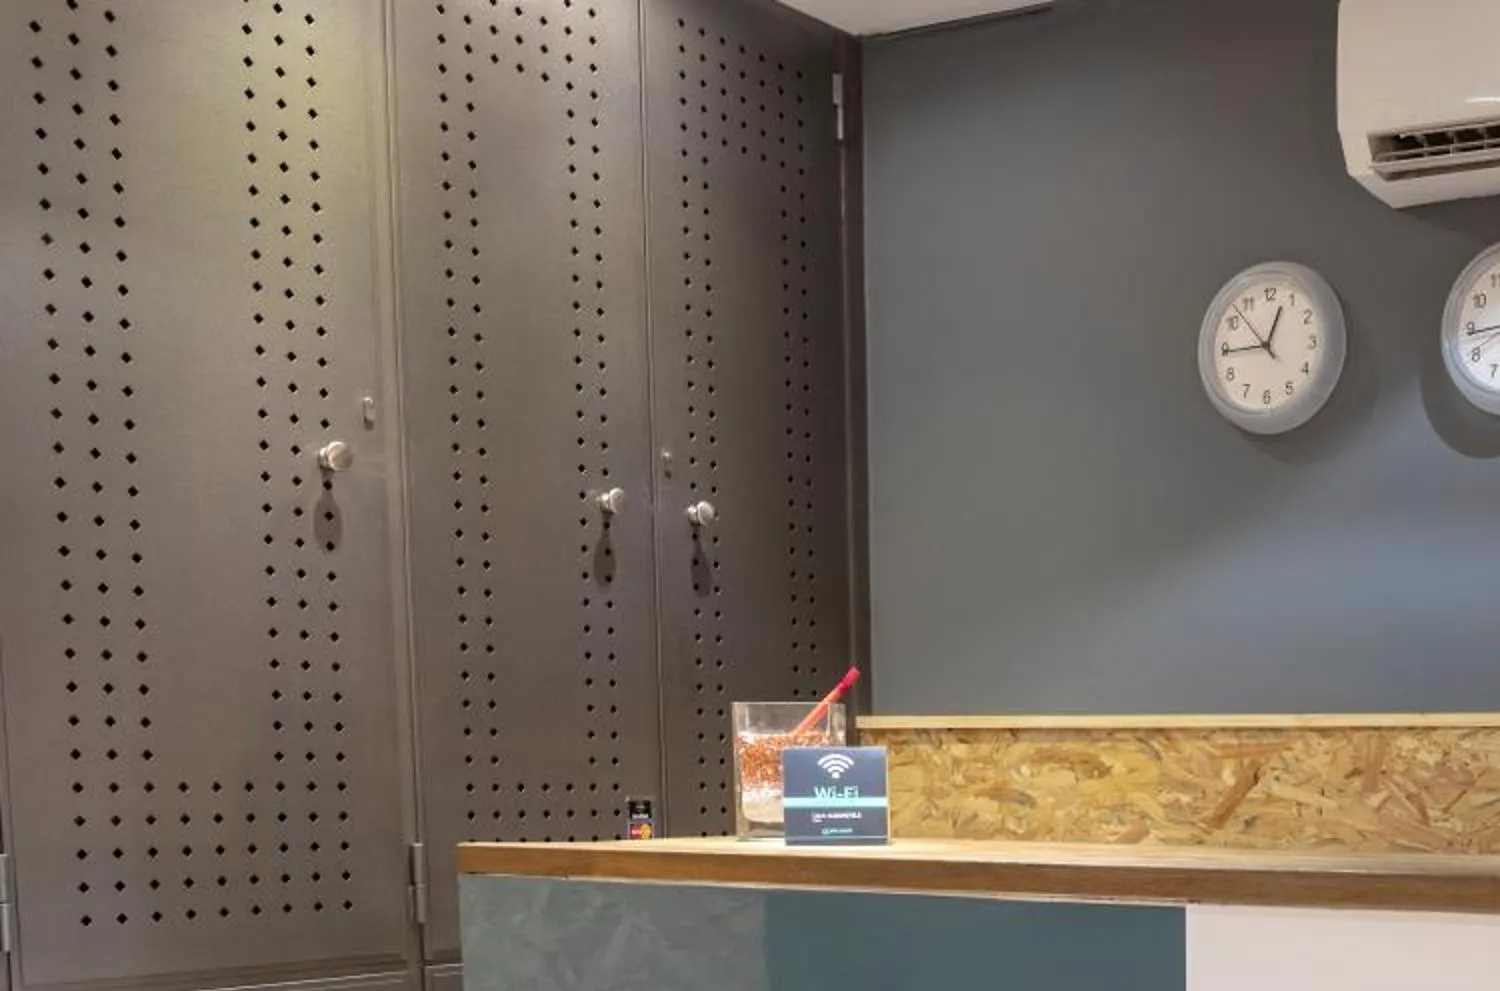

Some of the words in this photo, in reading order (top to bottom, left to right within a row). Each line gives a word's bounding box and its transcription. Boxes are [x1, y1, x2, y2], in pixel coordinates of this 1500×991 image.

[1264, 287, 1277, 302] 12
[1289, 293, 1295, 307] 1
[1472, 293, 1487, 309] 10
[1242, 297, 1255, 311] 11
[1225, 315, 1239, 331] 10
[1303, 308, 1313, 325] 2
[1466, 321, 1476, 336] 9
[1221, 342, 1230, 357] 9
[1308, 335, 1317, 350] 3
[1471, 347, 1481, 363] 8
[1225, 367, 1235, 382] 8
[1301, 361, 1309, 376] 4
[1489, 364, 1499, 378] 7
[1242, 383, 1251, 398] 7
[1285, 381, 1294, 395] 5
[1262, 390, 1271, 405] 6
[814, 786, 859, 802] Wi-Fi
